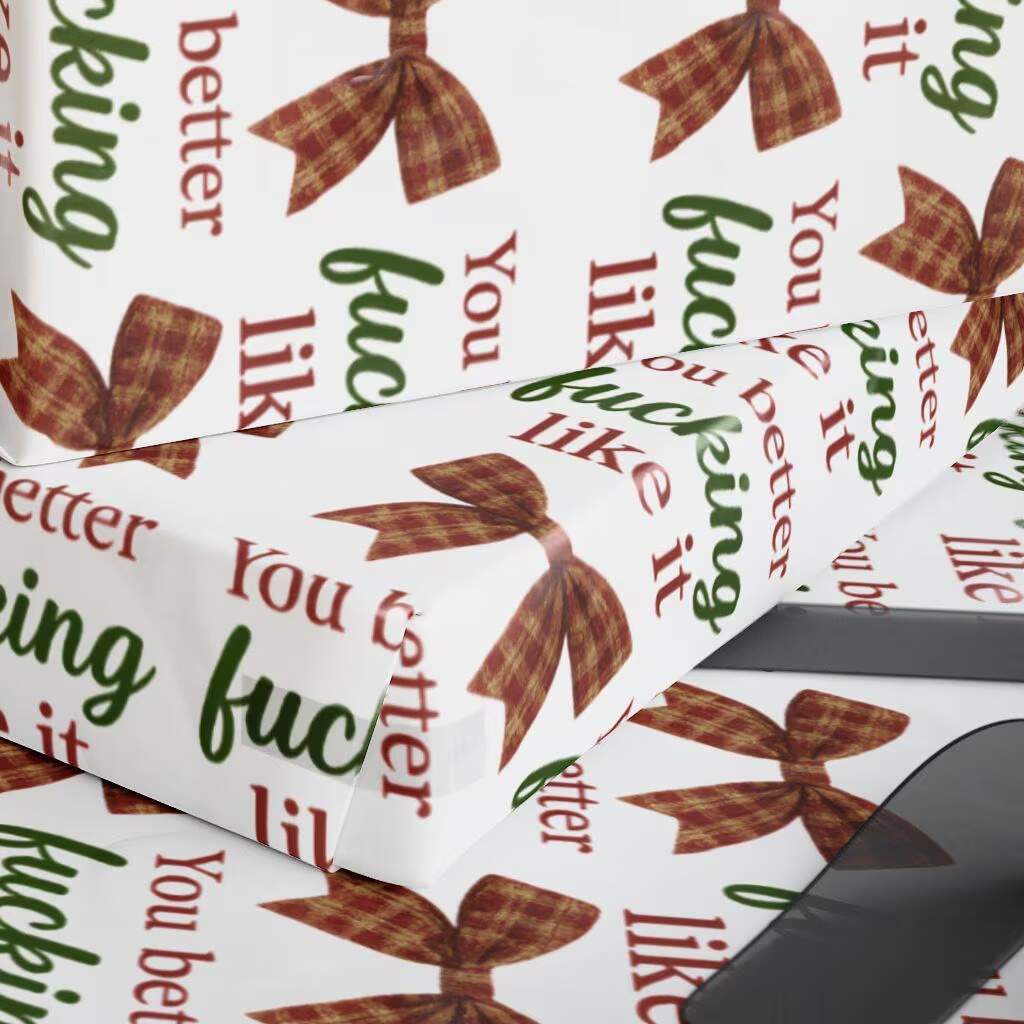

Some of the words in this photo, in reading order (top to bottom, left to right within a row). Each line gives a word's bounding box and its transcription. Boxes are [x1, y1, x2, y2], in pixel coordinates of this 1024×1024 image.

[862, 18, 927, 83] it
[178, 12, 240, 237] better
[461, 230, 518, 371] You
[785, 180, 840, 314] You
[237, 308, 317, 432] lik
[585, 252, 658, 368] lik
[641, 354, 729, 390] ou
[738, 376, 796, 582] better
[819, 397, 856, 474] it
[508, 411, 673, 516] like
[652, 532, 695, 619] it
[511, 366, 751, 634] fucking
[226, 536, 354, 633] You
[939, 532, 1024, 605] like
[36, 701, 91, 770] it
[143, 850, 226, 932] You
